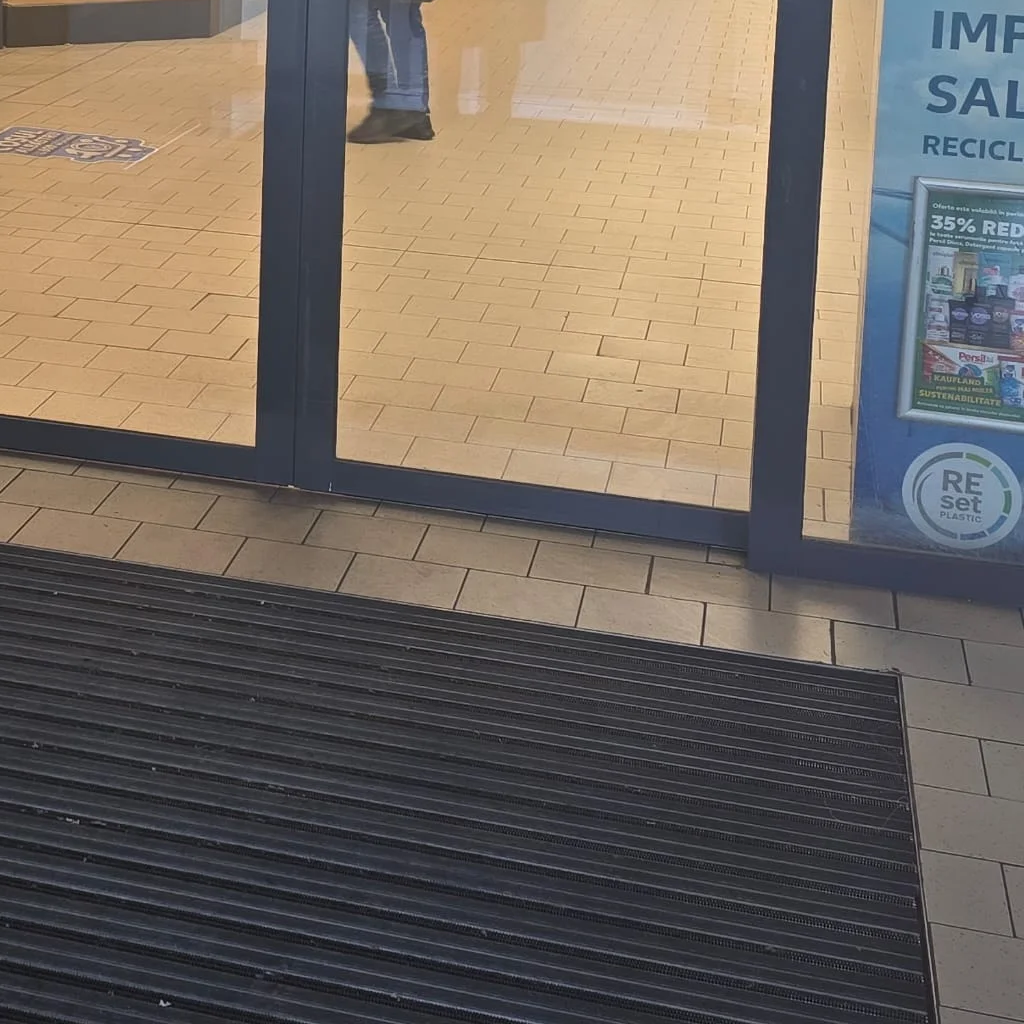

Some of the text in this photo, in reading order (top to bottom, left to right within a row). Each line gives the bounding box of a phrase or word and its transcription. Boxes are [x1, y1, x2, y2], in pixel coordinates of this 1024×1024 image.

[932, 10, 1024, 53] IMP
[926, 75, 1024, 119] SAL
[922, 135, 1023, 162] RECICL
[931, 215, 1024, 238] 35% RED
[958, 352, 986, 363] Persil
[933, 375, 981, 386] KAUFLAND
[919, 389, 1002, 407] SUSTENABILITATE
[942, 469, 984, 496] RE
[940, 511, 982, 523] PLASTIC
